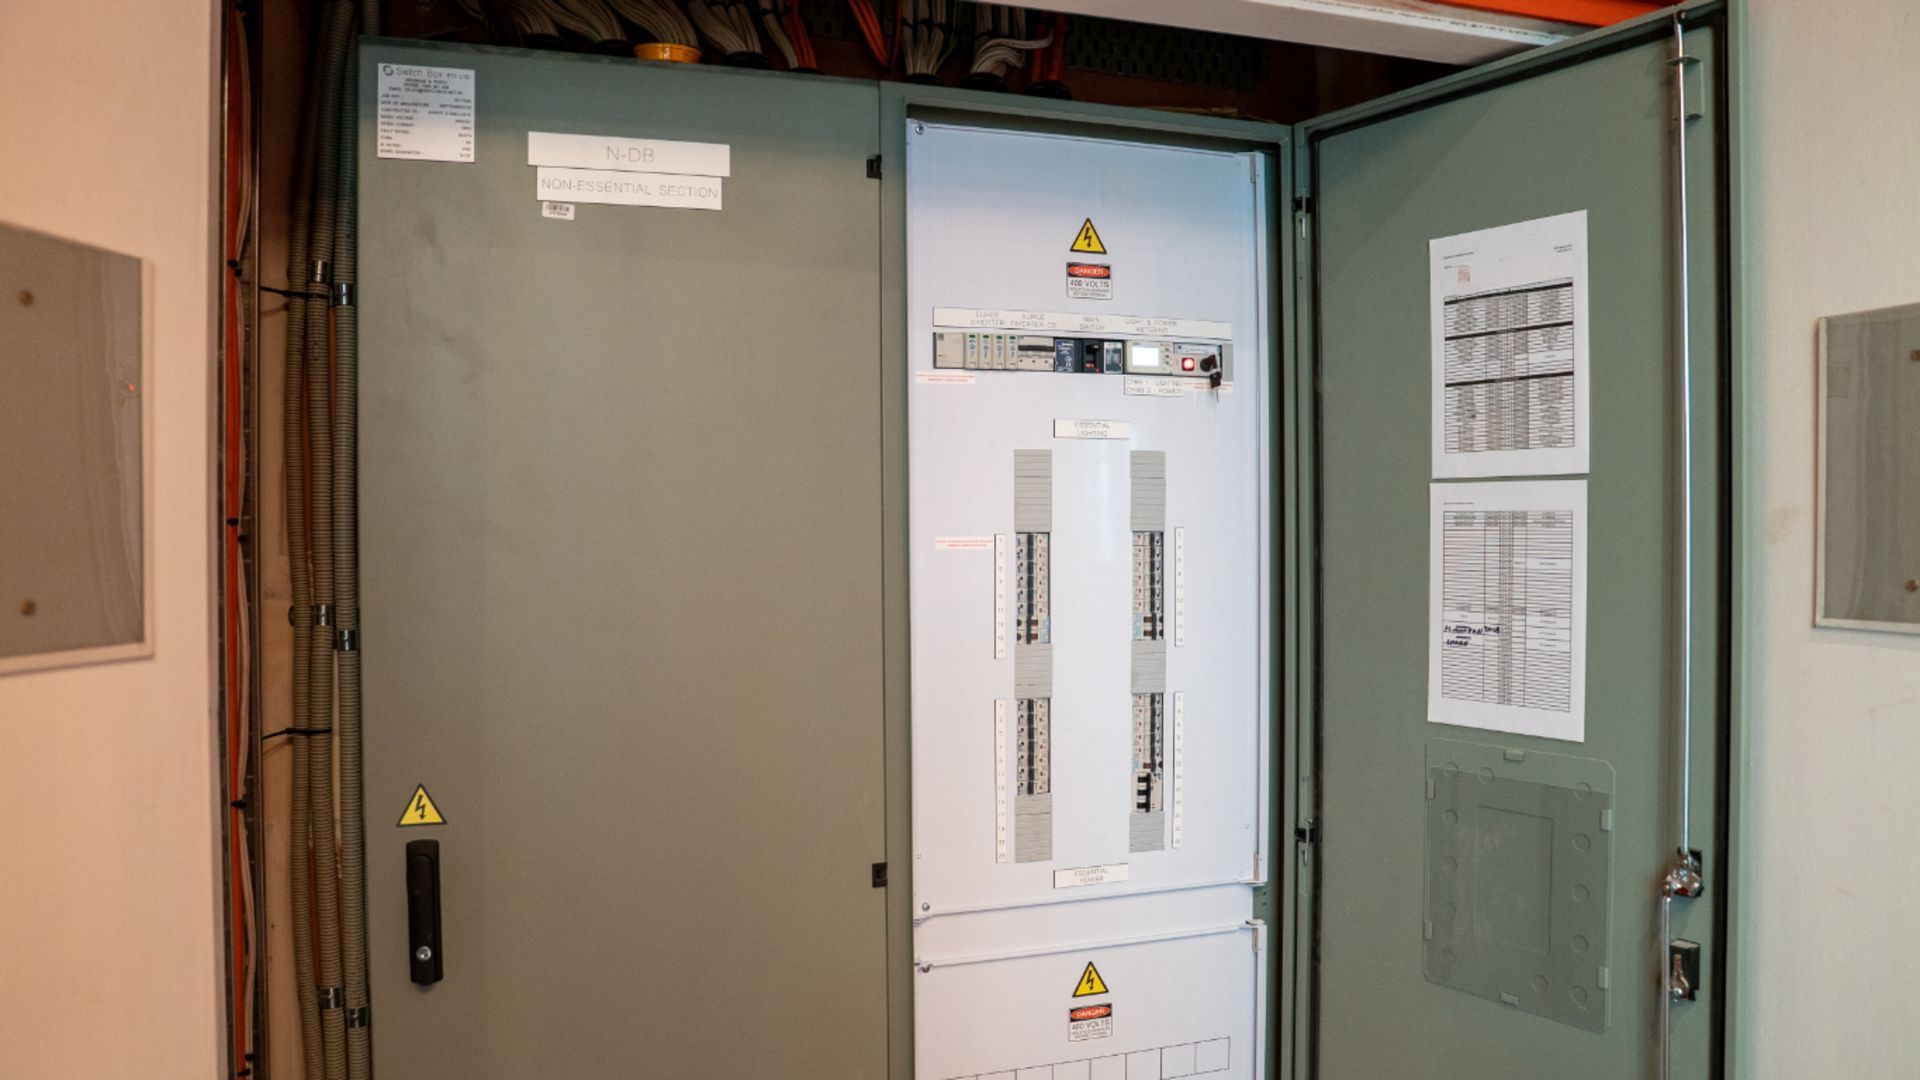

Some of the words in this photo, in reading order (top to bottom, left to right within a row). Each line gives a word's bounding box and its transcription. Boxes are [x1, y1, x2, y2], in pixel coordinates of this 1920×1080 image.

[396, 67, 422, 76] Switch
[427, 69, 442, 78] Box
[607, 146, 655, 163] N-DB
[540, 178, 652, 195] NON-ESSENTIAL
[659, 184, 718, 199] SECTION
[1074, 868, 1109, 876] ESSENTIAL
[1077, 1009, 1103, 1017] DANGER
[1085, 1019, 1110, 1028] VOLTS
